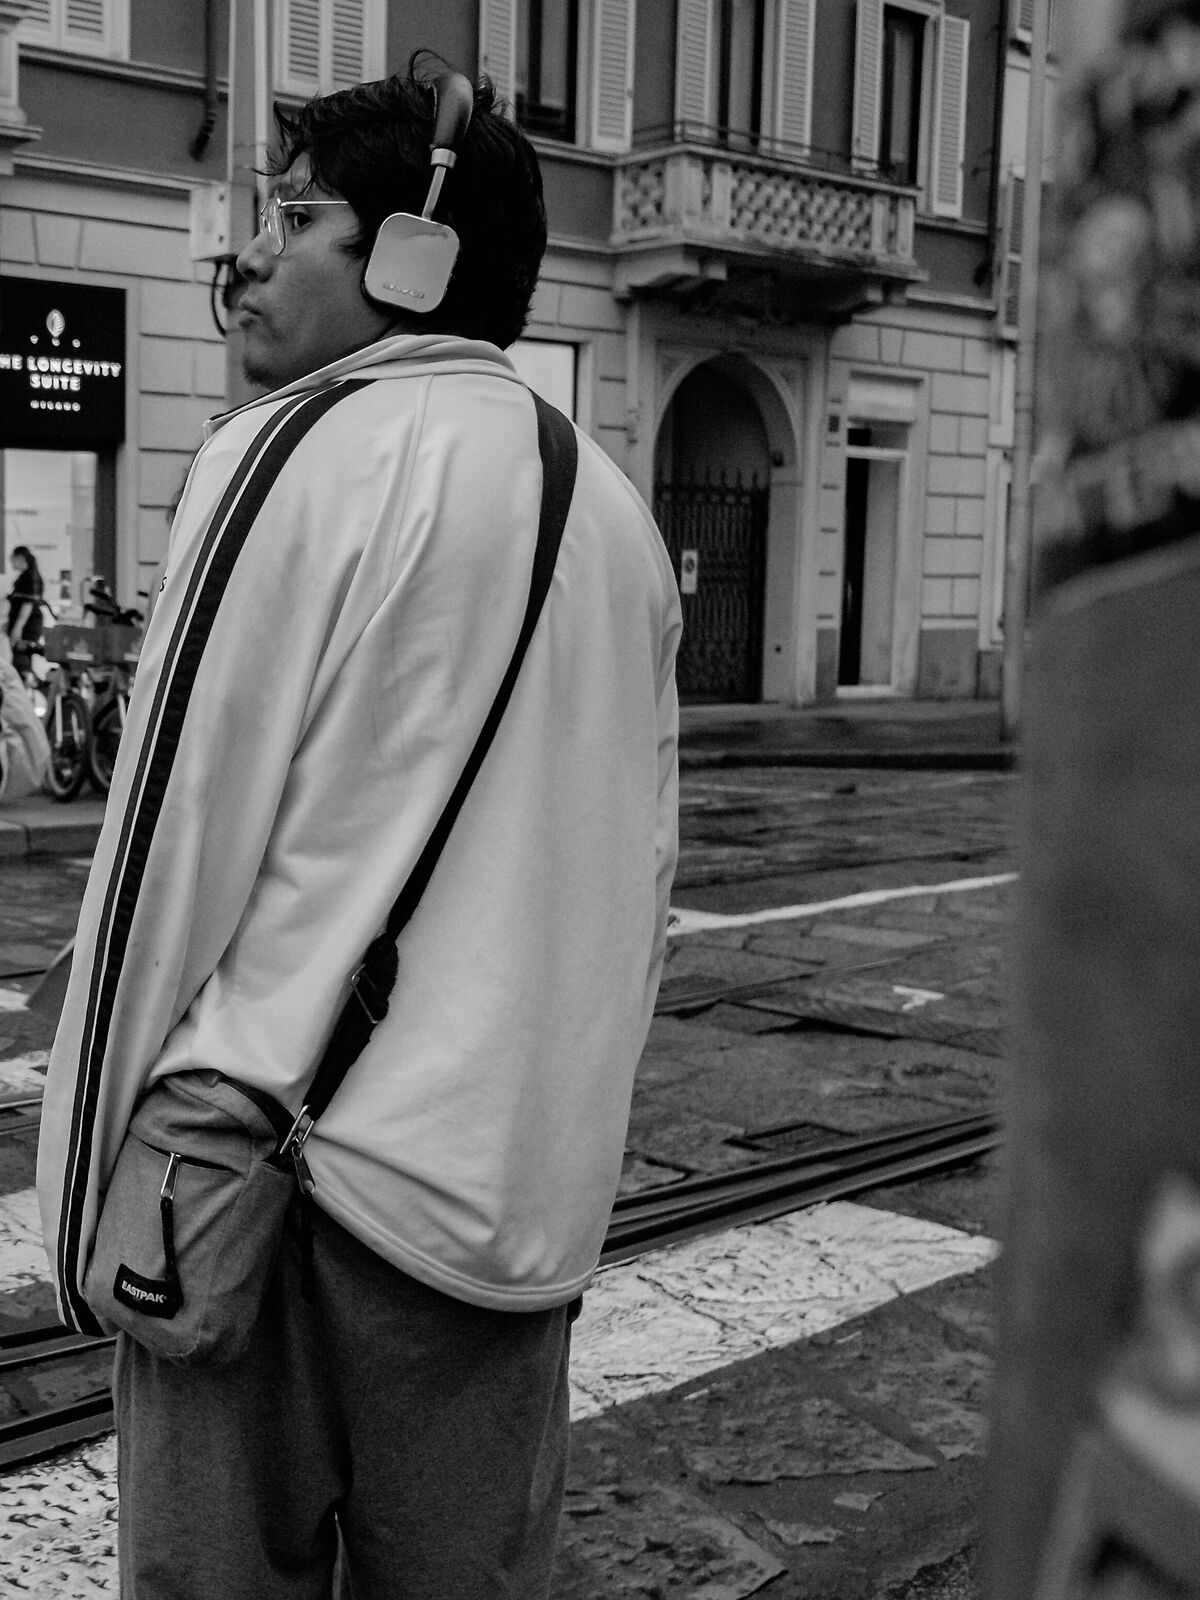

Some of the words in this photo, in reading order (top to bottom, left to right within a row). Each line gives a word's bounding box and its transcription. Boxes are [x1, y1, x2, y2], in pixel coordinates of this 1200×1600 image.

[27, 356, 121, 377] LONGEVITY
[30, 373, 81, 391] SUITE
[121, 1280, 164, 1303] EASTPAK
